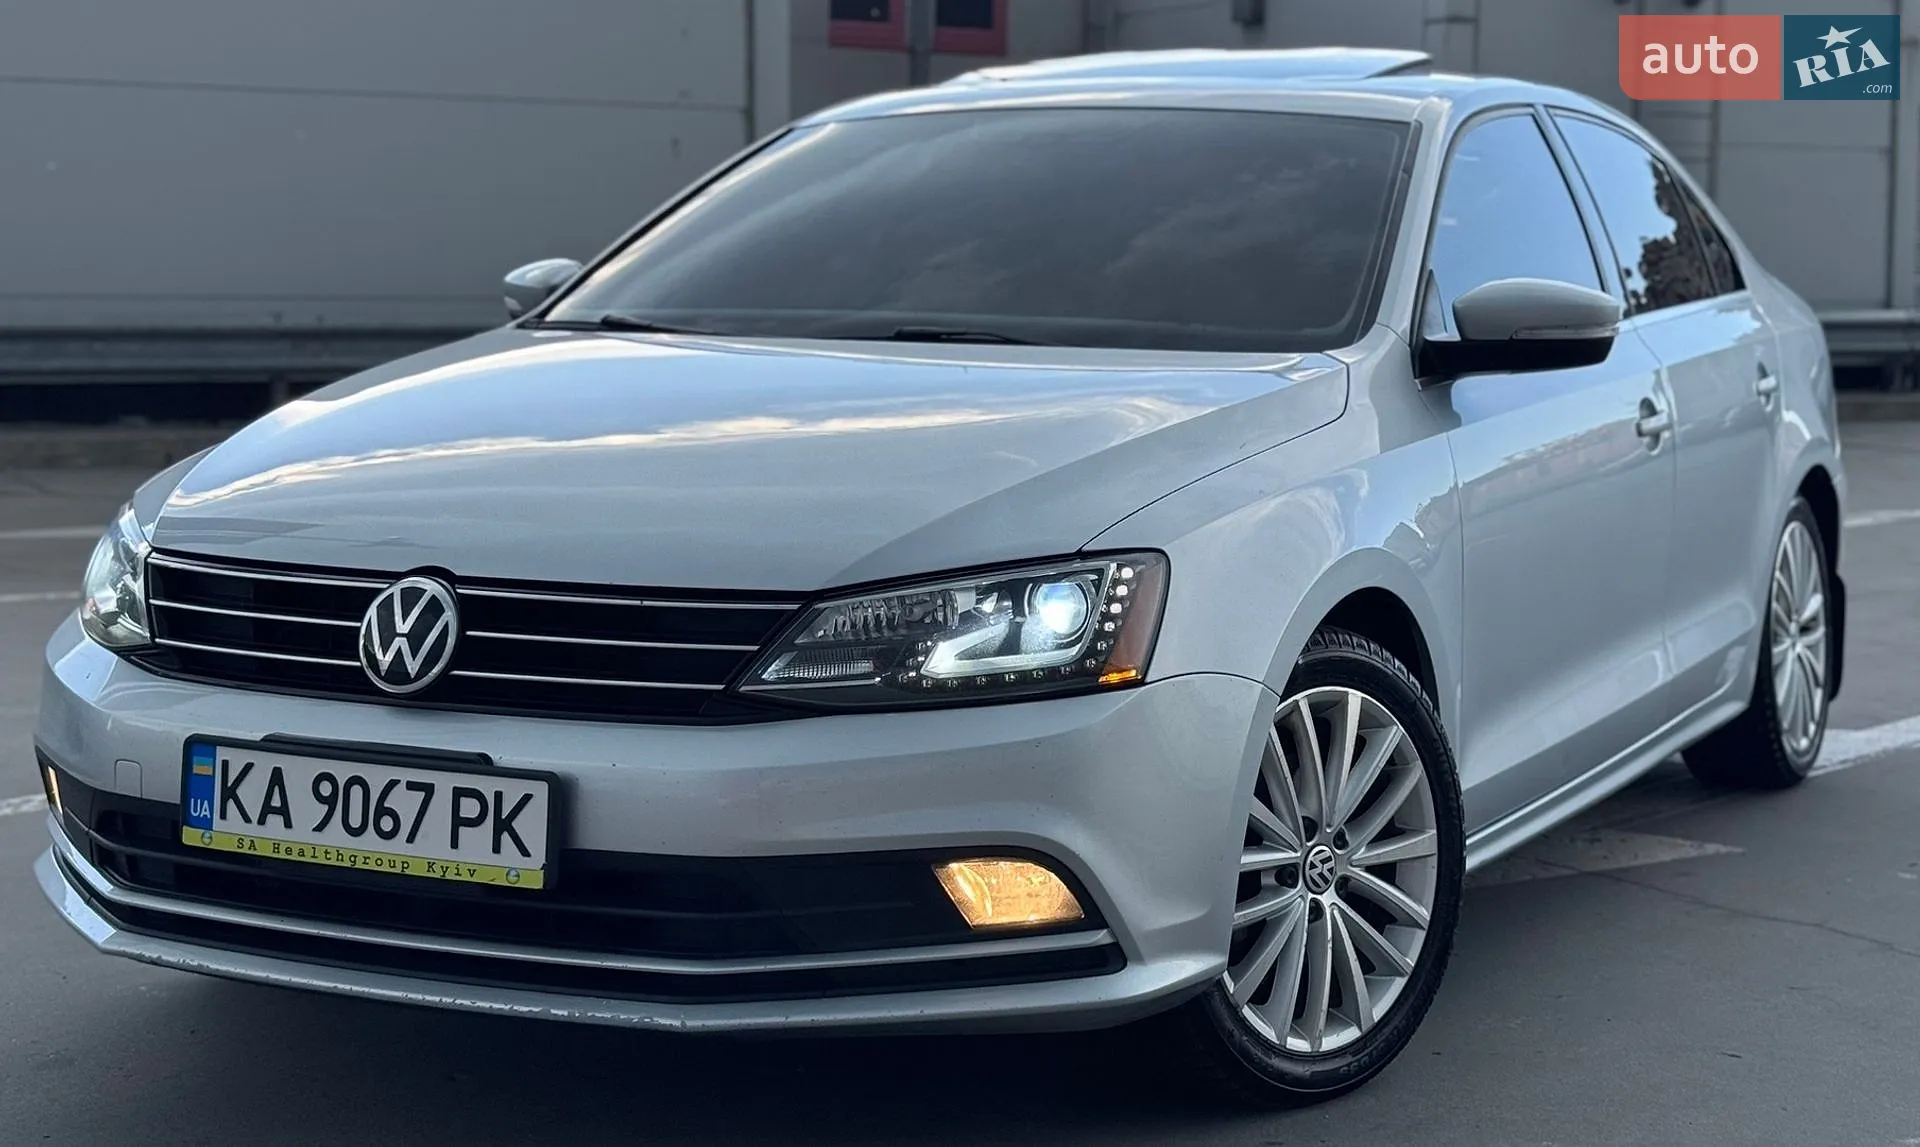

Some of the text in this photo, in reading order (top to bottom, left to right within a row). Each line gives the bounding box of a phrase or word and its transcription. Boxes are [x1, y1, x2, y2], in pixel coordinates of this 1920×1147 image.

[190, 798, 211, 819] UA
[219, 759, 534, 858] KA 9067 PK
[236, 837, 479, 882] SA Healthgroup Kyiv
